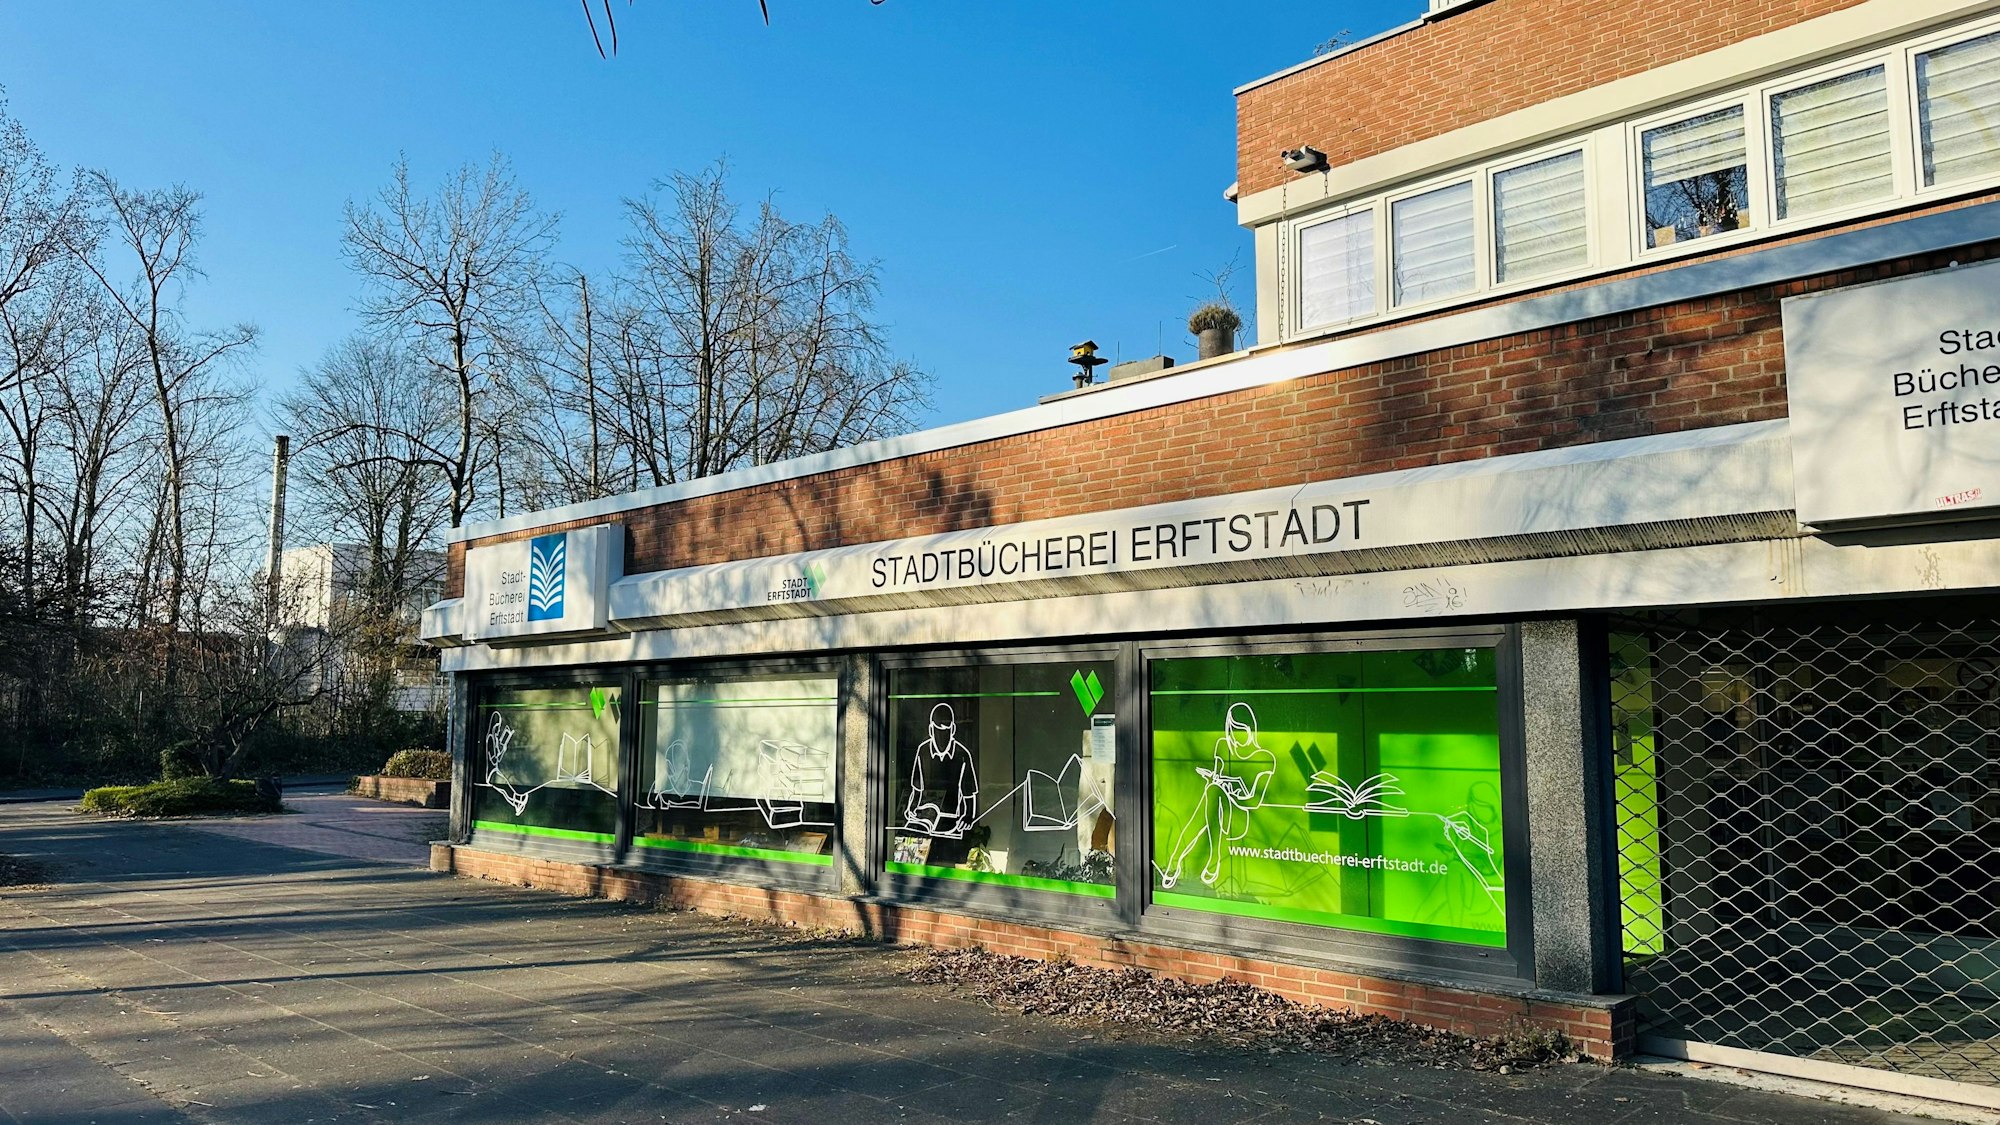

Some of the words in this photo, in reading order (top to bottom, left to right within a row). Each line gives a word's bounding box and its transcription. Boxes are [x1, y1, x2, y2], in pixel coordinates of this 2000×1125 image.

[1939, 329, 2000, 355] Sta
[871, 530, 1117, 588] STADTBÜCHEREI
[1131, 499, 1370, 562] ERFTSTADT
[501, 570, 526, 585] Stadt-
[782, 577, 808, 589] STADT
[489, 589, 525, 606] Bücherei
[767, 587, 812, 601] ERFTSTADT
[490, 610, 524, 626] Erftstadt
[1228, 845, 1448, 875] www.stadtbuecherei-erftstadt.de
